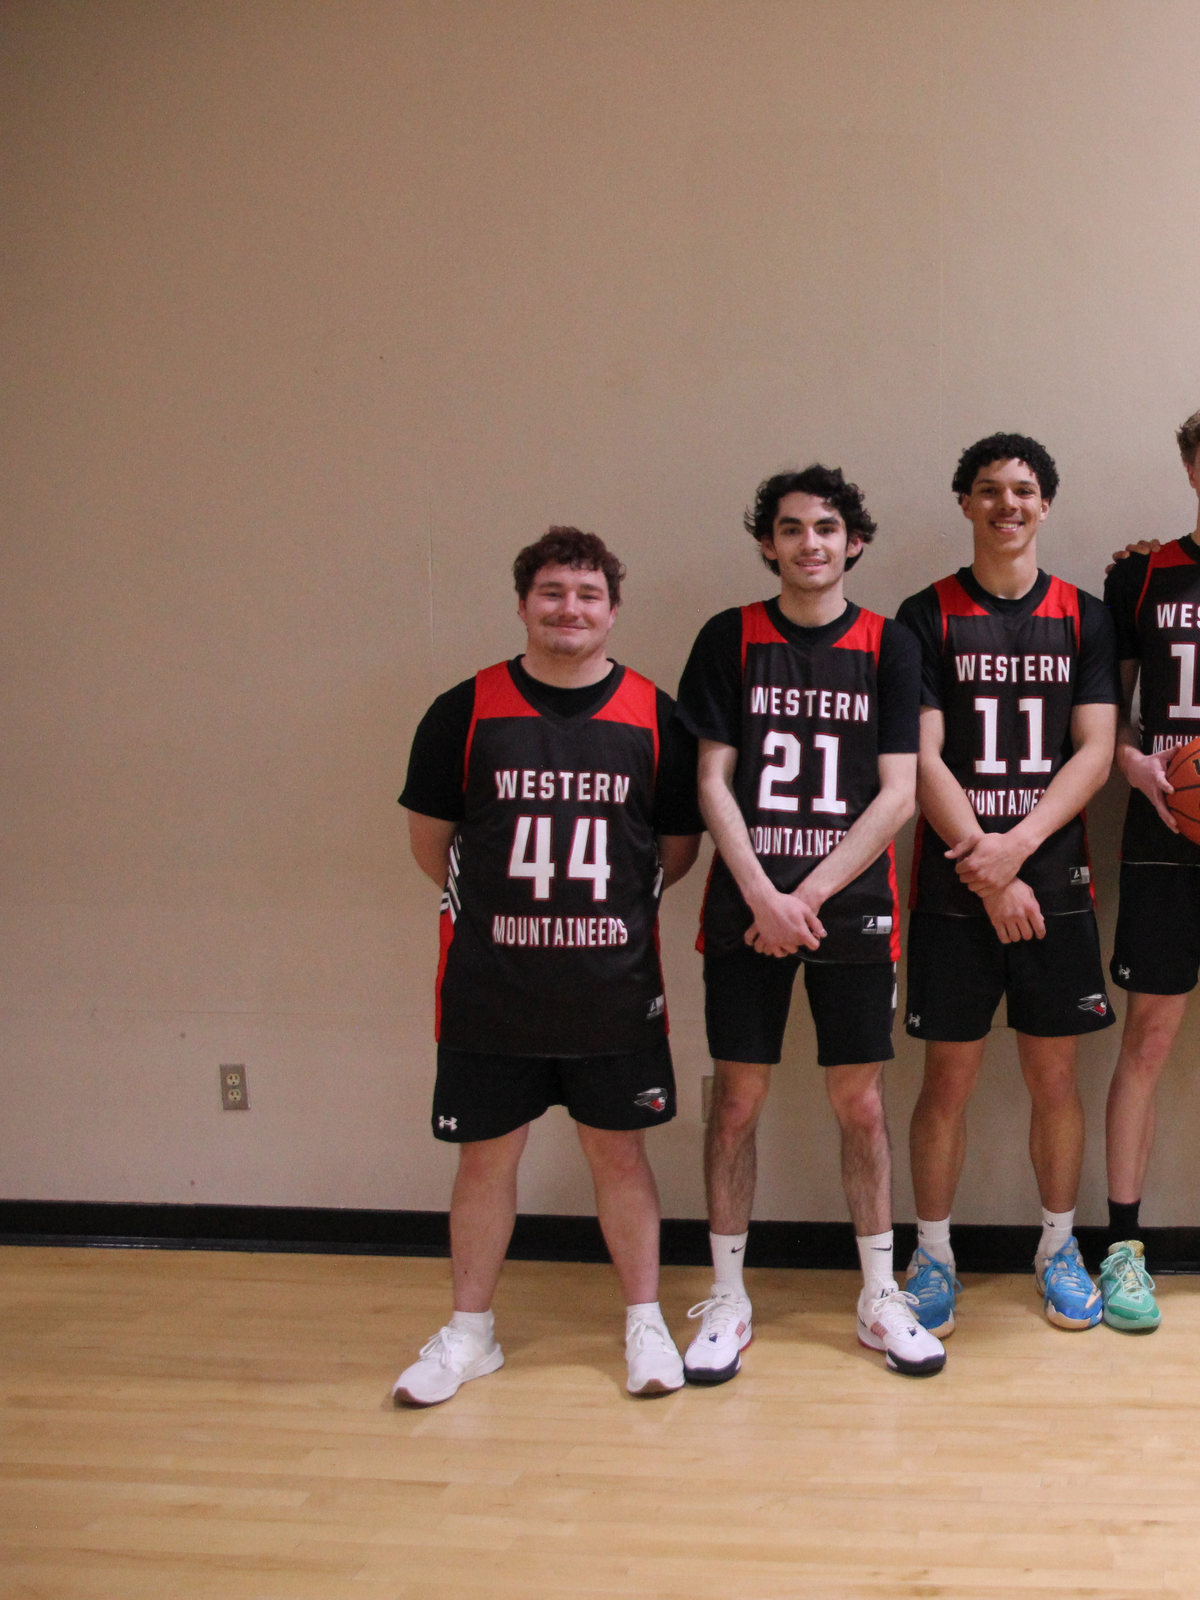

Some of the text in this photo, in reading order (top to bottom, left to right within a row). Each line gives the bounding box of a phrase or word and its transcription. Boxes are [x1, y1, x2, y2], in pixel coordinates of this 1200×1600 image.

[955, 655, 1071, 683] WESTERN
[751, 687, 869, 722] WESTERN
[974, 697, 1053, 774] 11
[495, 770, 630, 804] WESTERN
[758, 730, 847, 814] 21
[964, 788, 1047, 815] UNTAINE
[749, 826, 847, 856] OUNTAINE
[508, 816, 612, 902] 44
[492, 915, 629, 947] MOUNTAINEERS
